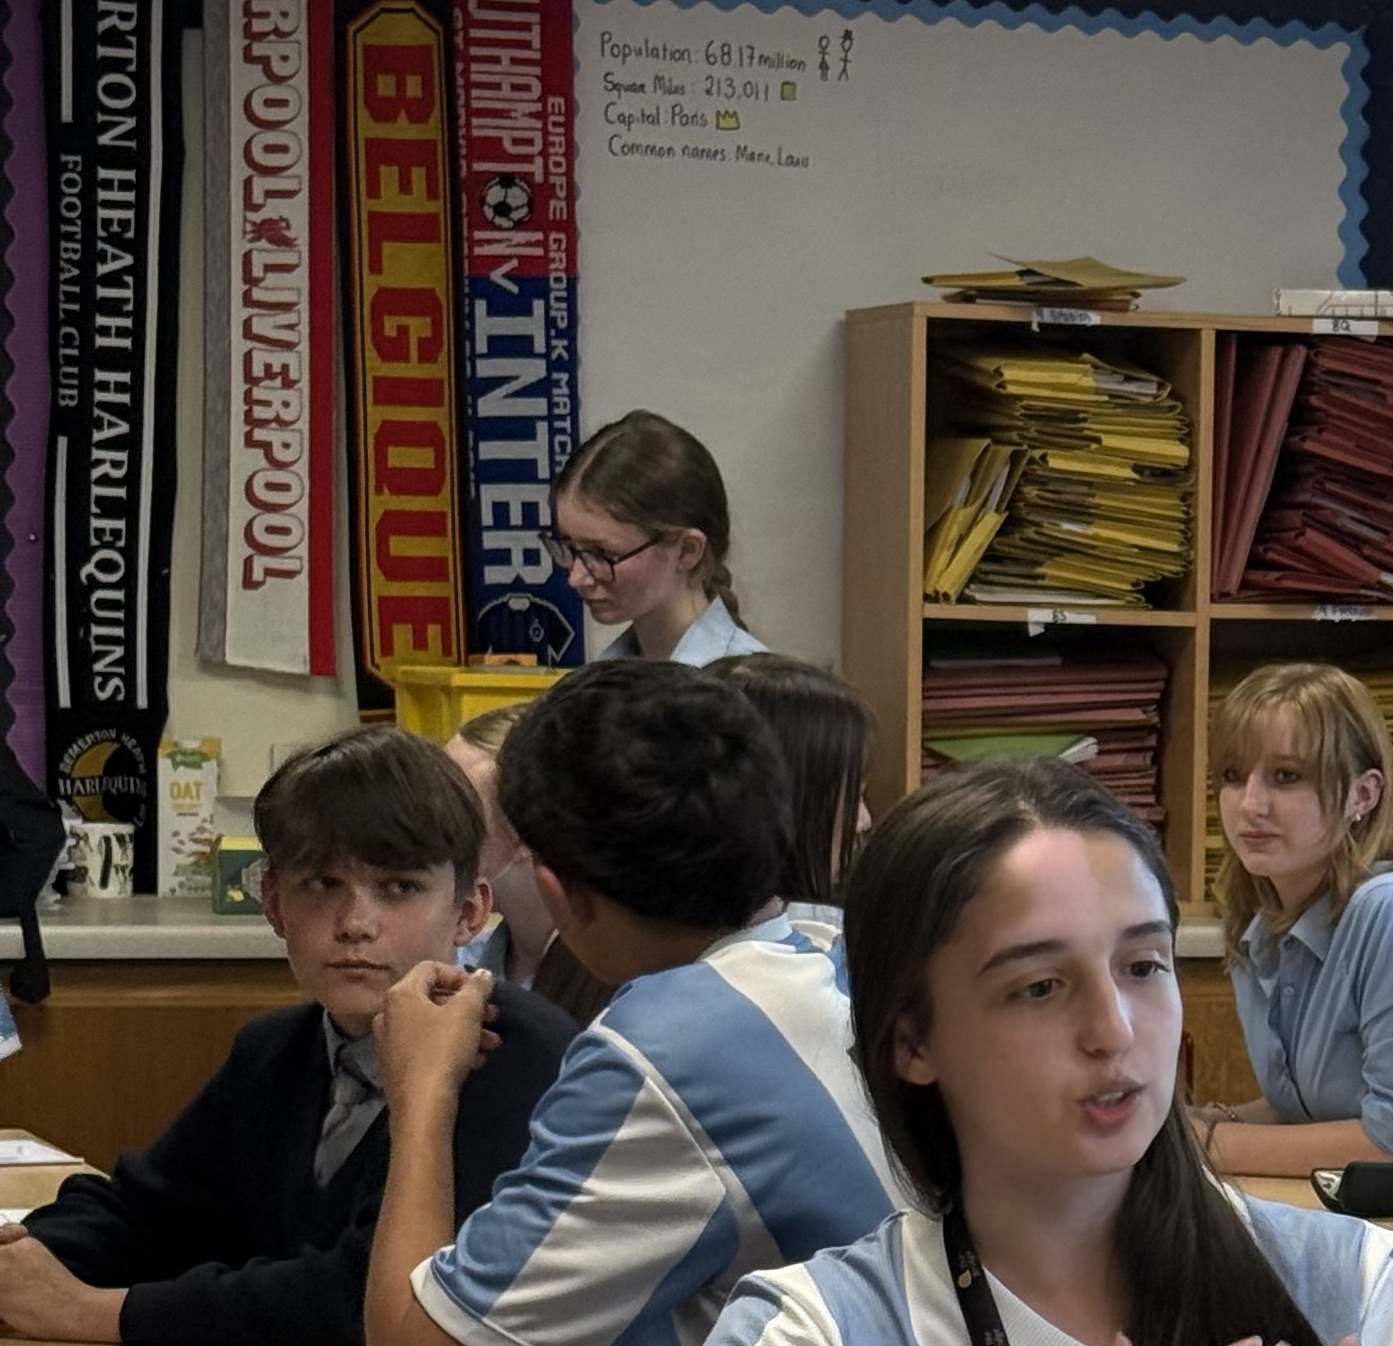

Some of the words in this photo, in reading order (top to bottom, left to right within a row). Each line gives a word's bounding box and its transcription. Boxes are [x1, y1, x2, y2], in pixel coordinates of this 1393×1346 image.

[671, 104, 708, 127] Paris
[704, 75, 770, 101] 213,011
[758, 49, 806, 71] million
[547, 96, 568, 220] EUROPE
[608, 134, 676, 158] Common
[58, 154, 82, 319] FOOTBALL
[94, 165, 137, 351] HEATH
[57, 326, 80, 409] CLUB
[363, 44, 454, 659] BELGIQUE
[242, 249, 305, 590] LIVERPOOL
[474, 300, 554, 584] INTER
[80, 369, 132, 702] HARLEQUINS
[170, 780, 203, 801] OAT
